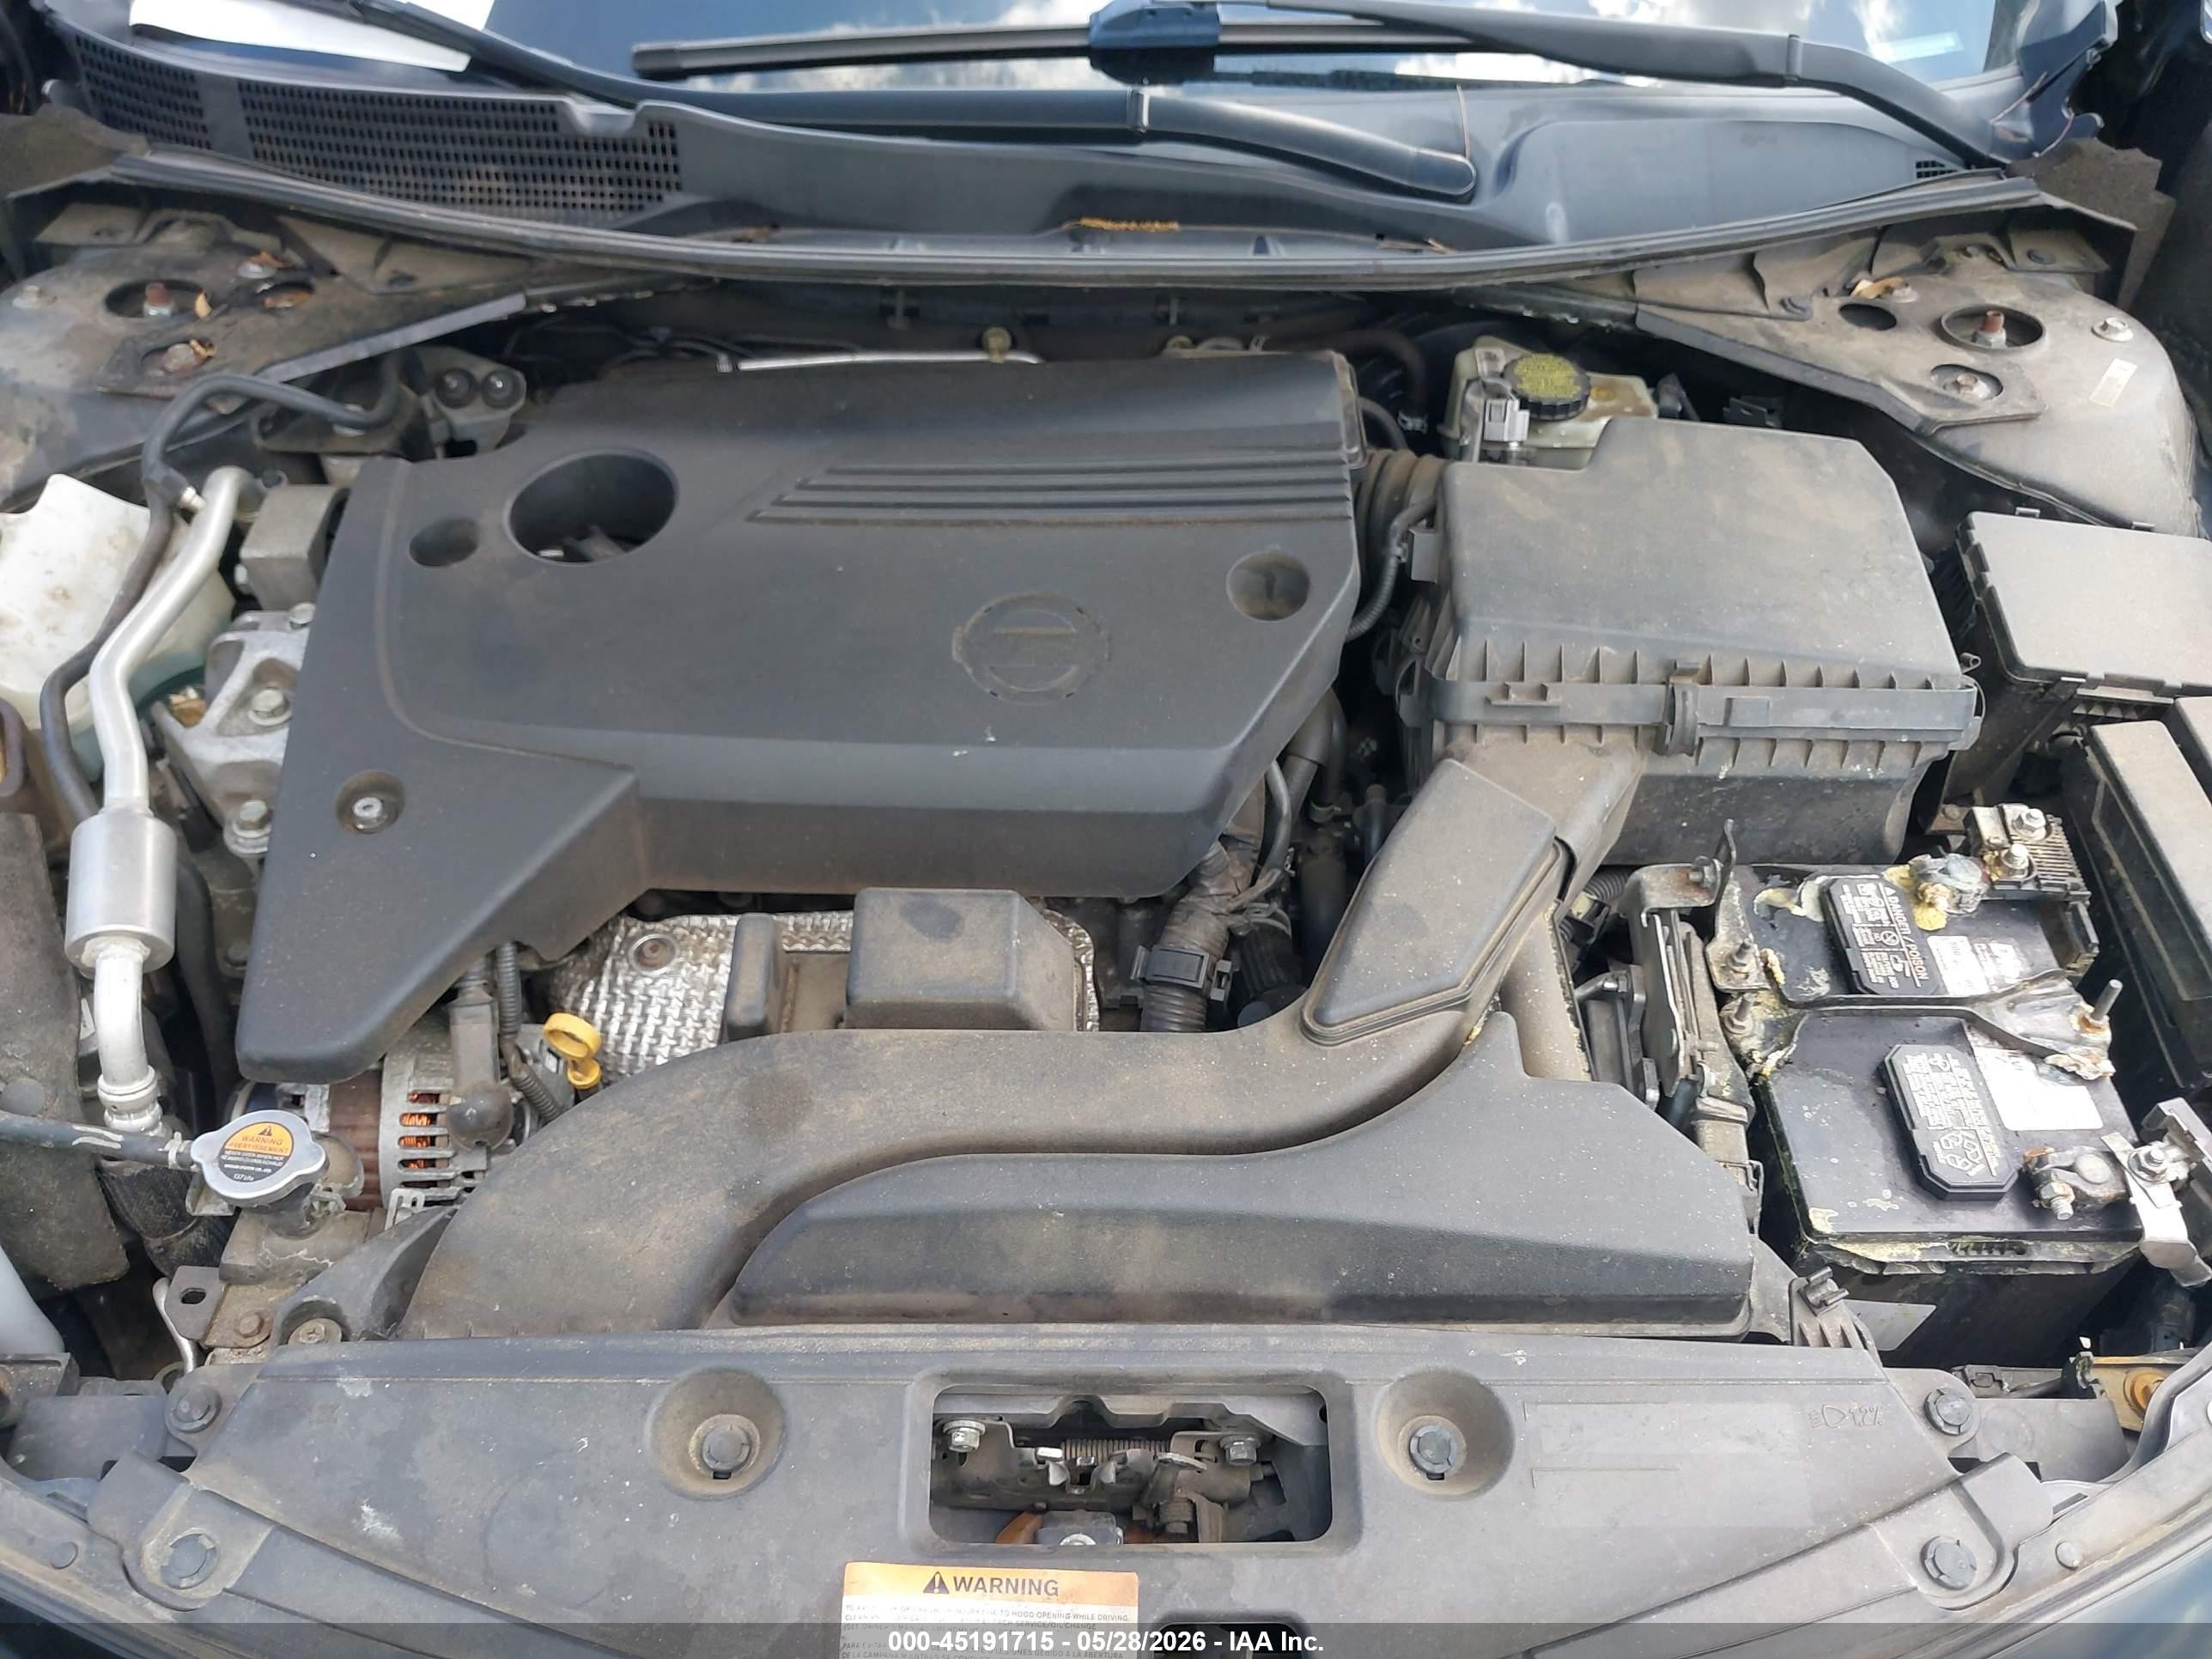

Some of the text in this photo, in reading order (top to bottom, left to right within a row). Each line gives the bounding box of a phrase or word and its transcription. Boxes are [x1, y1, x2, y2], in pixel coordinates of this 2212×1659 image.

[1887, 895, 1912, 940] DANGER
[1908, 944, 1930, 981] POISON
[241, 1135, 283, 1146] WARNING
[953, 1576, 1059, 1597] WARNING
[1012, 1610, 1035, 1619] HOOD
[1036, 1611, 1071, 1620] OPENING
[1072, 1613, 1096, 1621] WHILE
[1064, 1622, 1097, 1631] CHANGE
